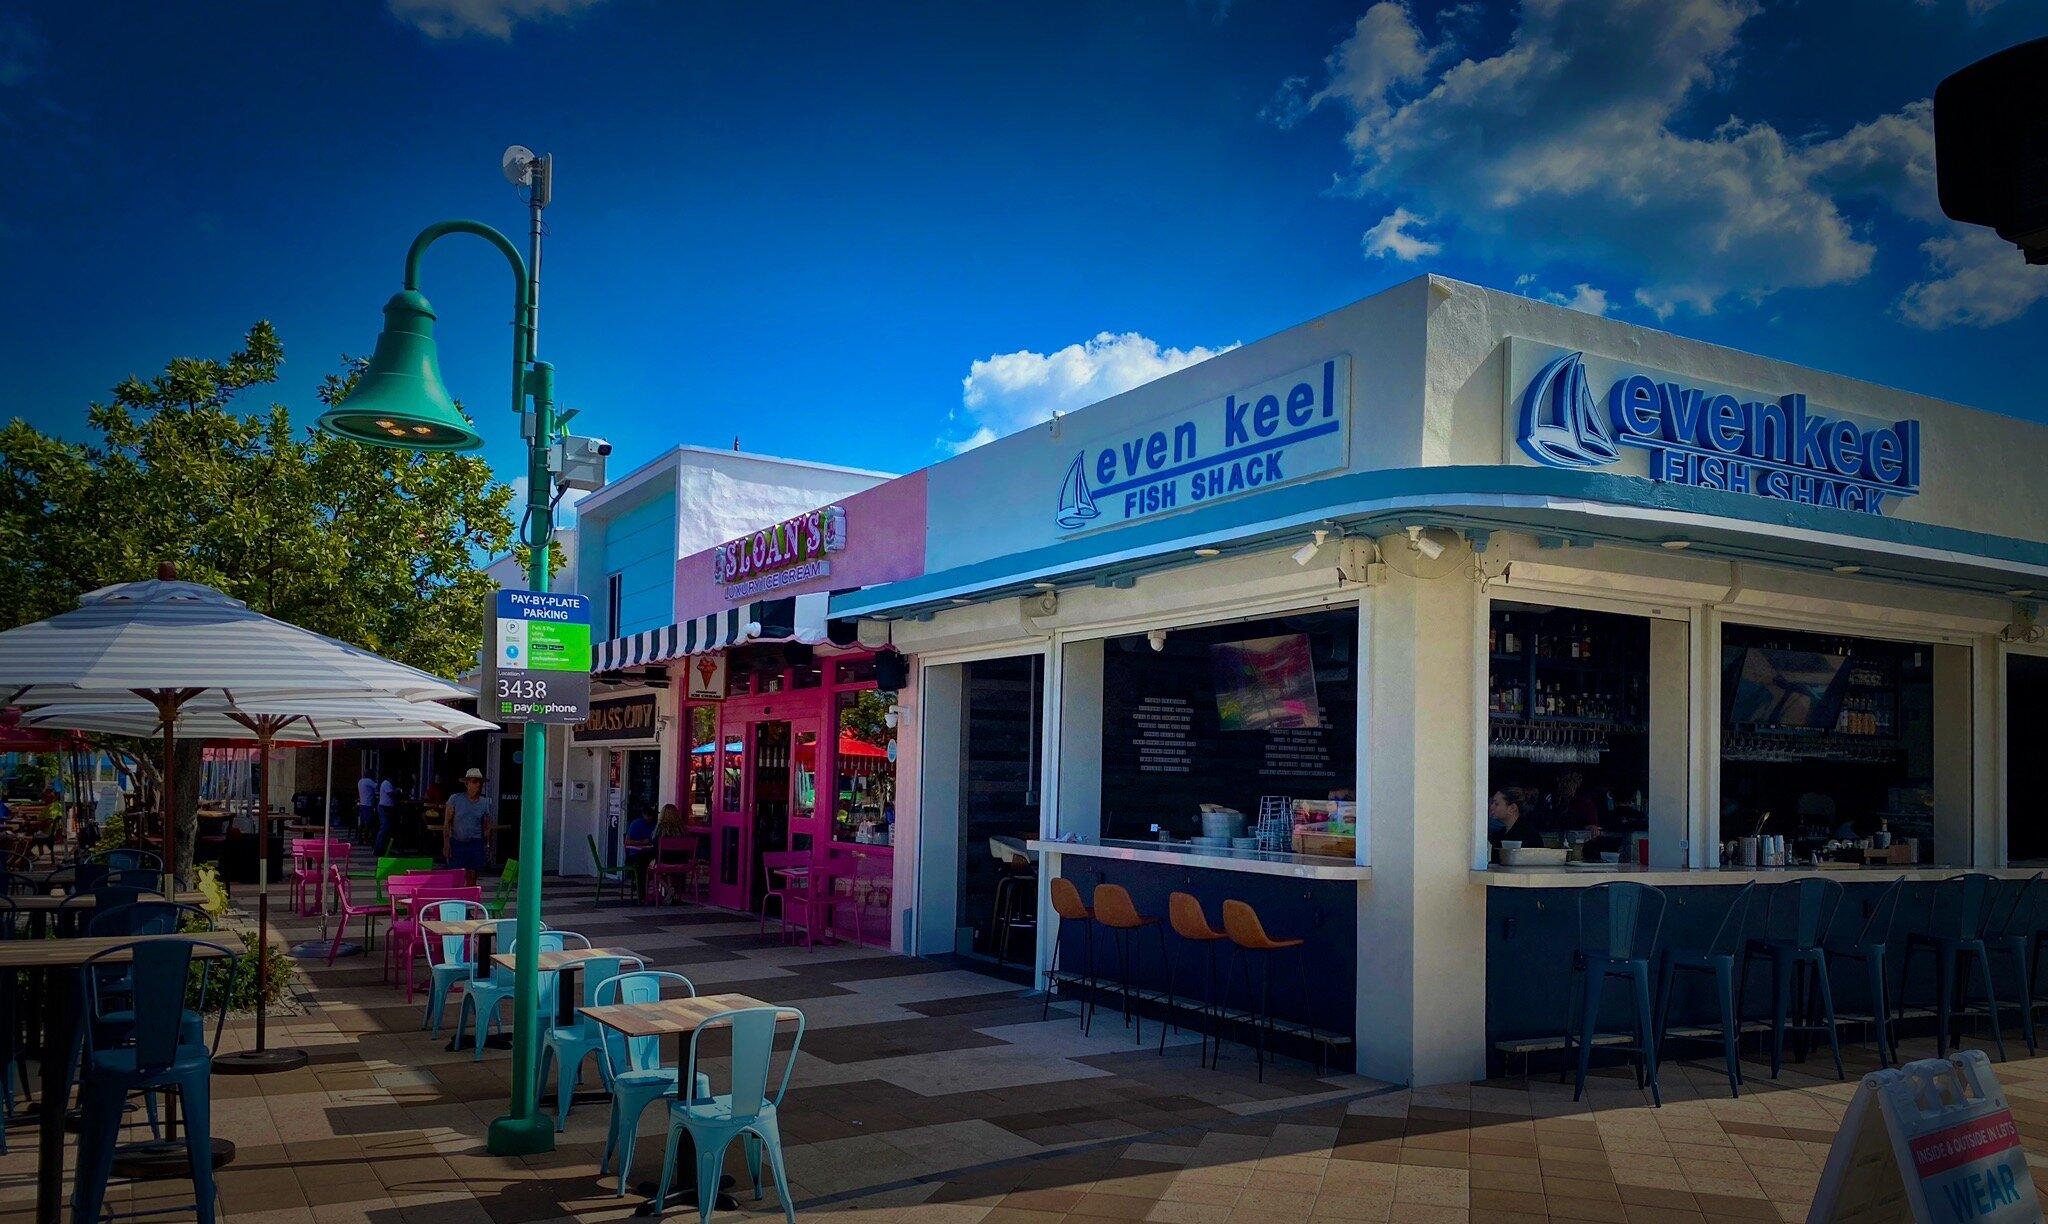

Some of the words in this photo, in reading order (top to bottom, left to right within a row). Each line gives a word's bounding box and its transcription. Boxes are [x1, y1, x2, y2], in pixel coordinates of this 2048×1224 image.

[1097, 421, 1196, 484] even
[1225, 361, 1334, 447] keel
[1125, 481, 1176, 518] FISH
[1191, 451, 1283, 501] SHACK
[1651, 448, 1751, 493] FISH
[1758, 471, 1885, 516] SHACK
[725, 511, 821, 580] SLOAN'S
[724, 579, 761, 600] LUXURY
[762, 571, 779, 591] ICE
[780, 560, 821, 585] CREAM
[511, 594, 580, 608] PAY-BY-PLATE
[523, 608, 568, 620] PARKING
[498, 679, 547, 699] 3438
[513, 702, 577, 714] paybyphone
[1917, 1142, 1946, 1164] INSIDE
[1954, 1127, 1988, 1152] OUTSIDE
[1987, 1124, 1996, 1142] IN
[1943, 1164, 2021, 1223] WEAR
